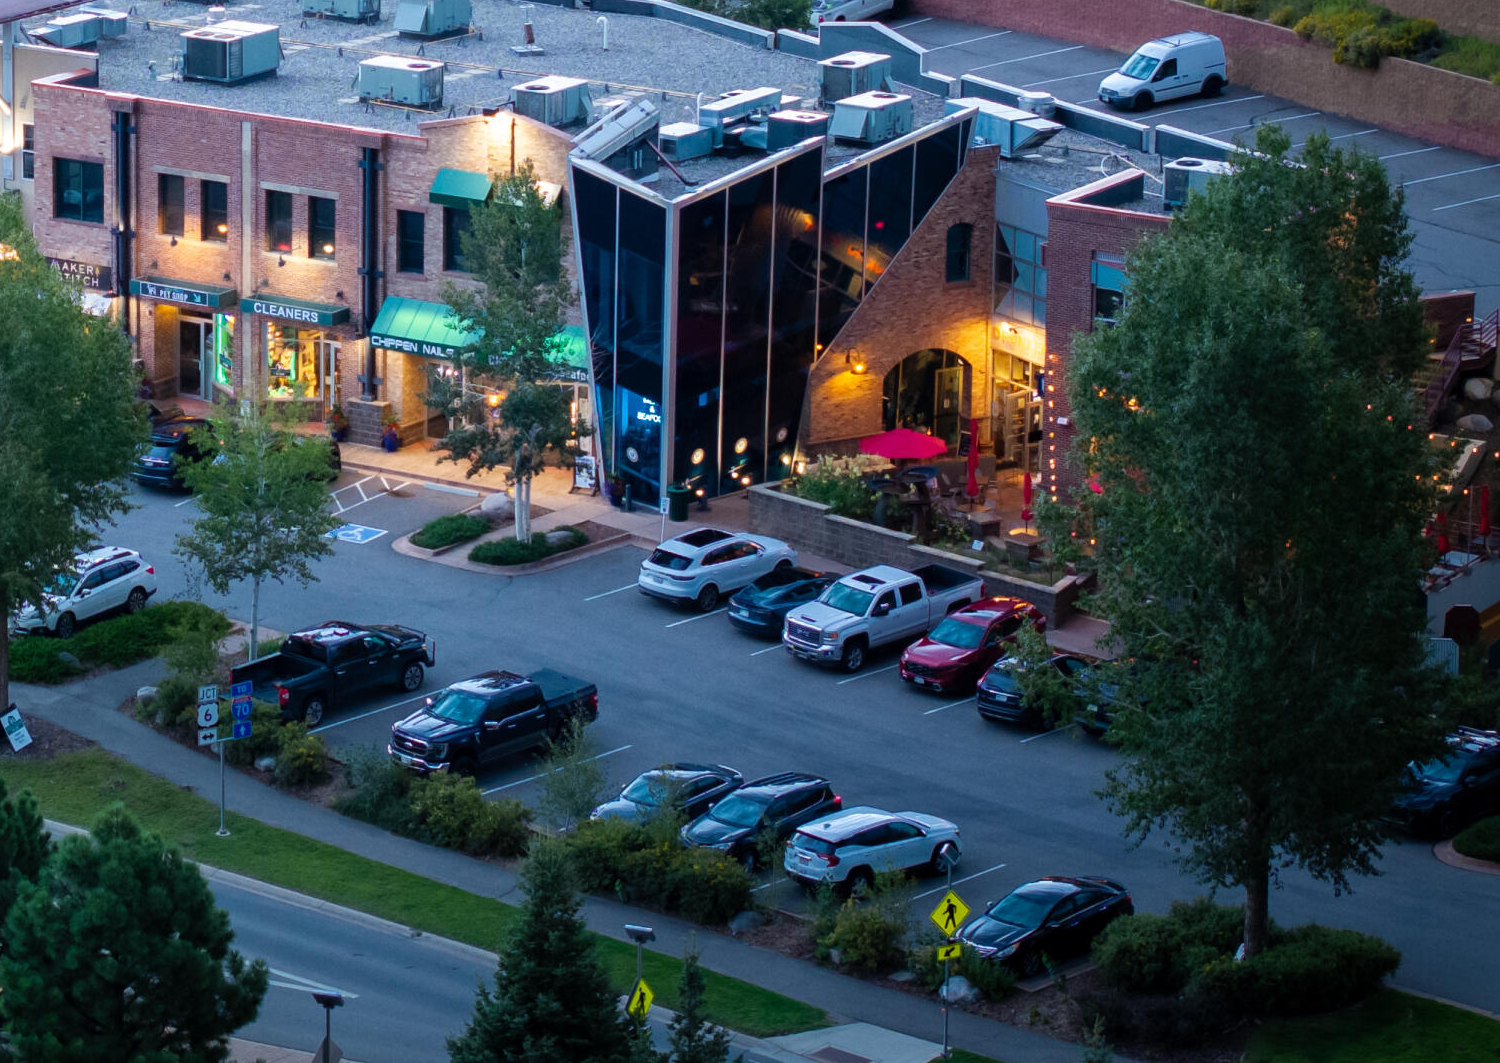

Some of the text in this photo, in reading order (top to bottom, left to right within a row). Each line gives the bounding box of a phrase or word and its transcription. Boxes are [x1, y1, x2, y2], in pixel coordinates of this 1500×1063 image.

[253, 302, 319, 323] CLEANERS
[200, 687, 217, 700] JCT
[203, 708, 213, 722] 6
[234, 703, 250, 717] 70
